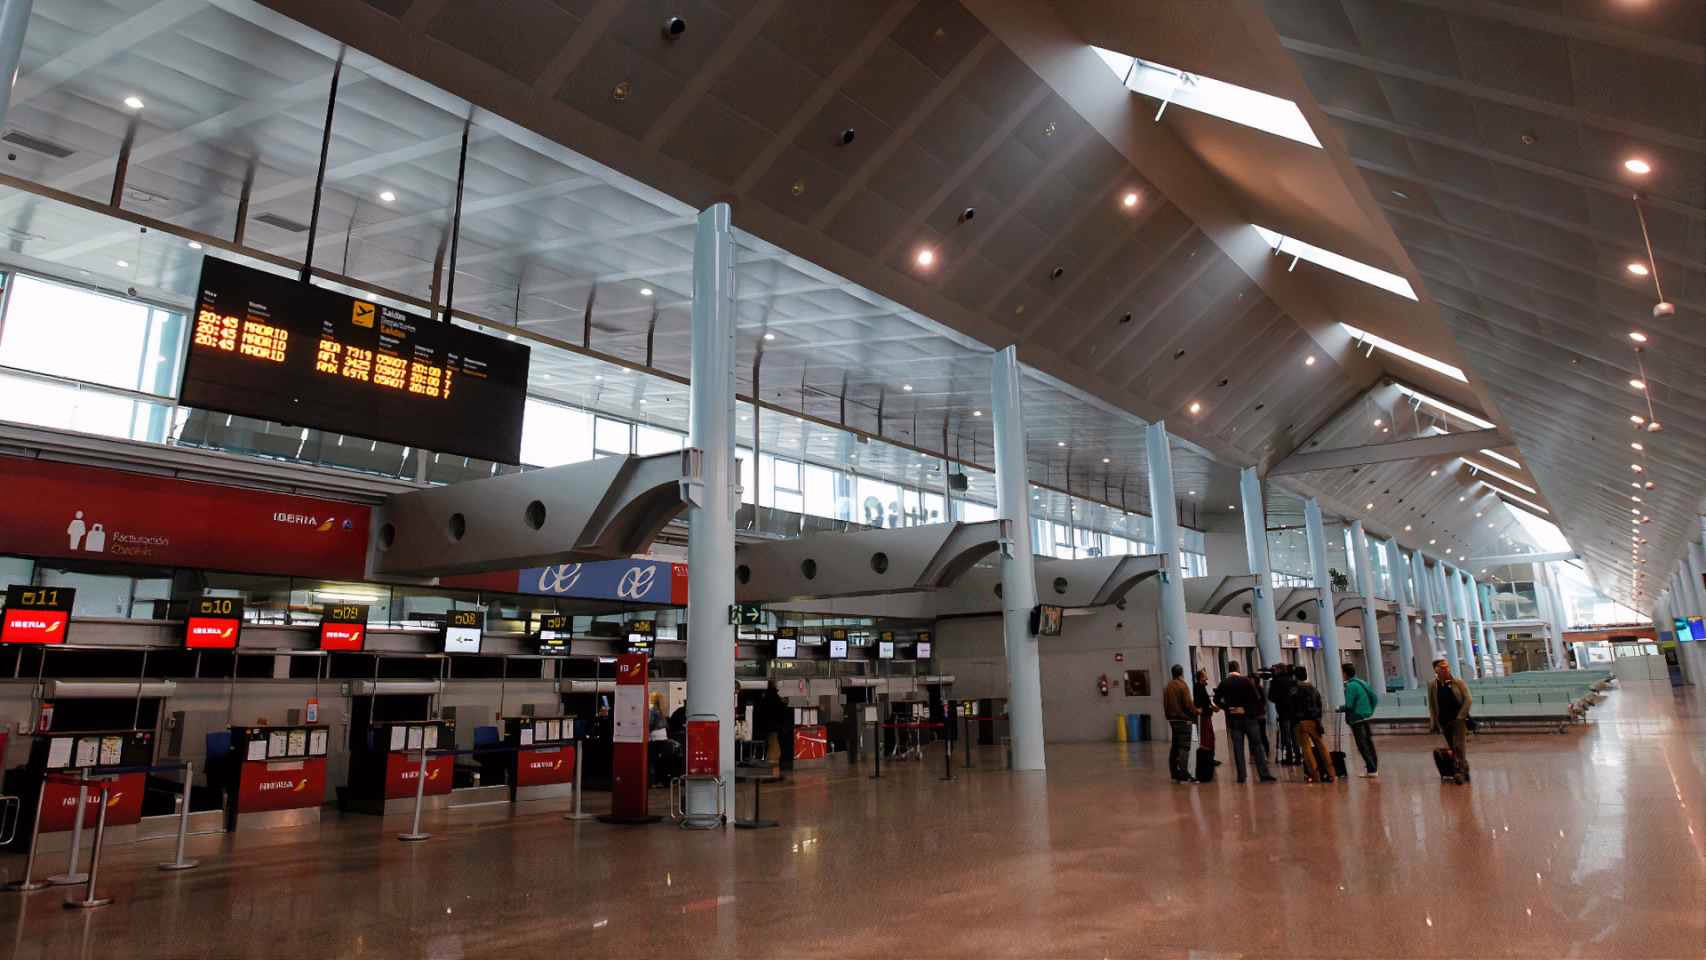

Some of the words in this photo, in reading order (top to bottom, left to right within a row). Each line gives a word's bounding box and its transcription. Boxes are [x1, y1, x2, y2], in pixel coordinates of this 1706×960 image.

[196, 321, 237, 340] 20:45
[242, 332, 286, 351] MADRID
[199, 310, 239, 329] 20:45
[244, 321, 288, 341] MADRID
[194, 332, 235, 351] 20:45
[240, 343, 285, 362] MADRID
[273, 512, 317, 526] IBERIA
[36, 591, 58, 606] 11
[213, 600, 231, 614] 10
